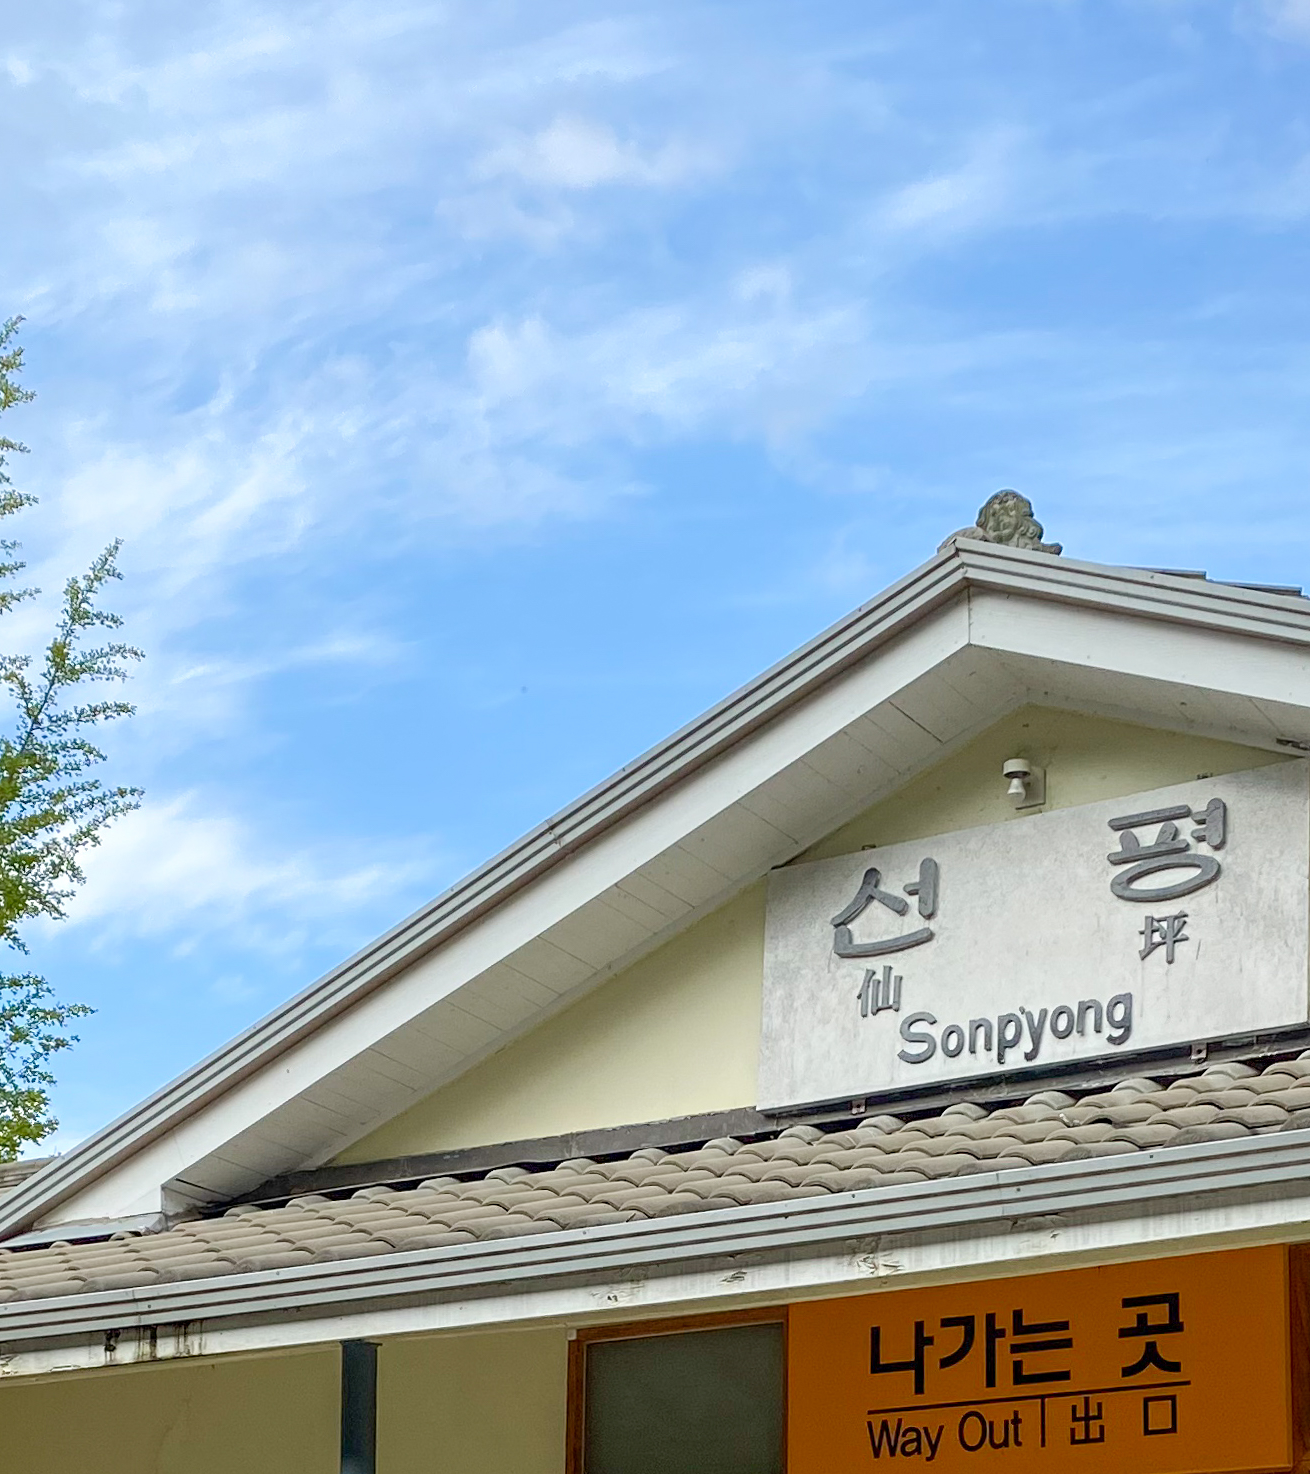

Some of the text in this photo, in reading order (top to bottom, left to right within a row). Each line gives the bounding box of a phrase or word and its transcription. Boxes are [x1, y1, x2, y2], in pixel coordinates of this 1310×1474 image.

[830, 797, 1228, 959] 선 평
[856, 909, 1189, 1018] 仙 坪
[869, 1291, 1185, 1395] 나가는 곳
[866, 1409, 1024, 1463] Way Out
